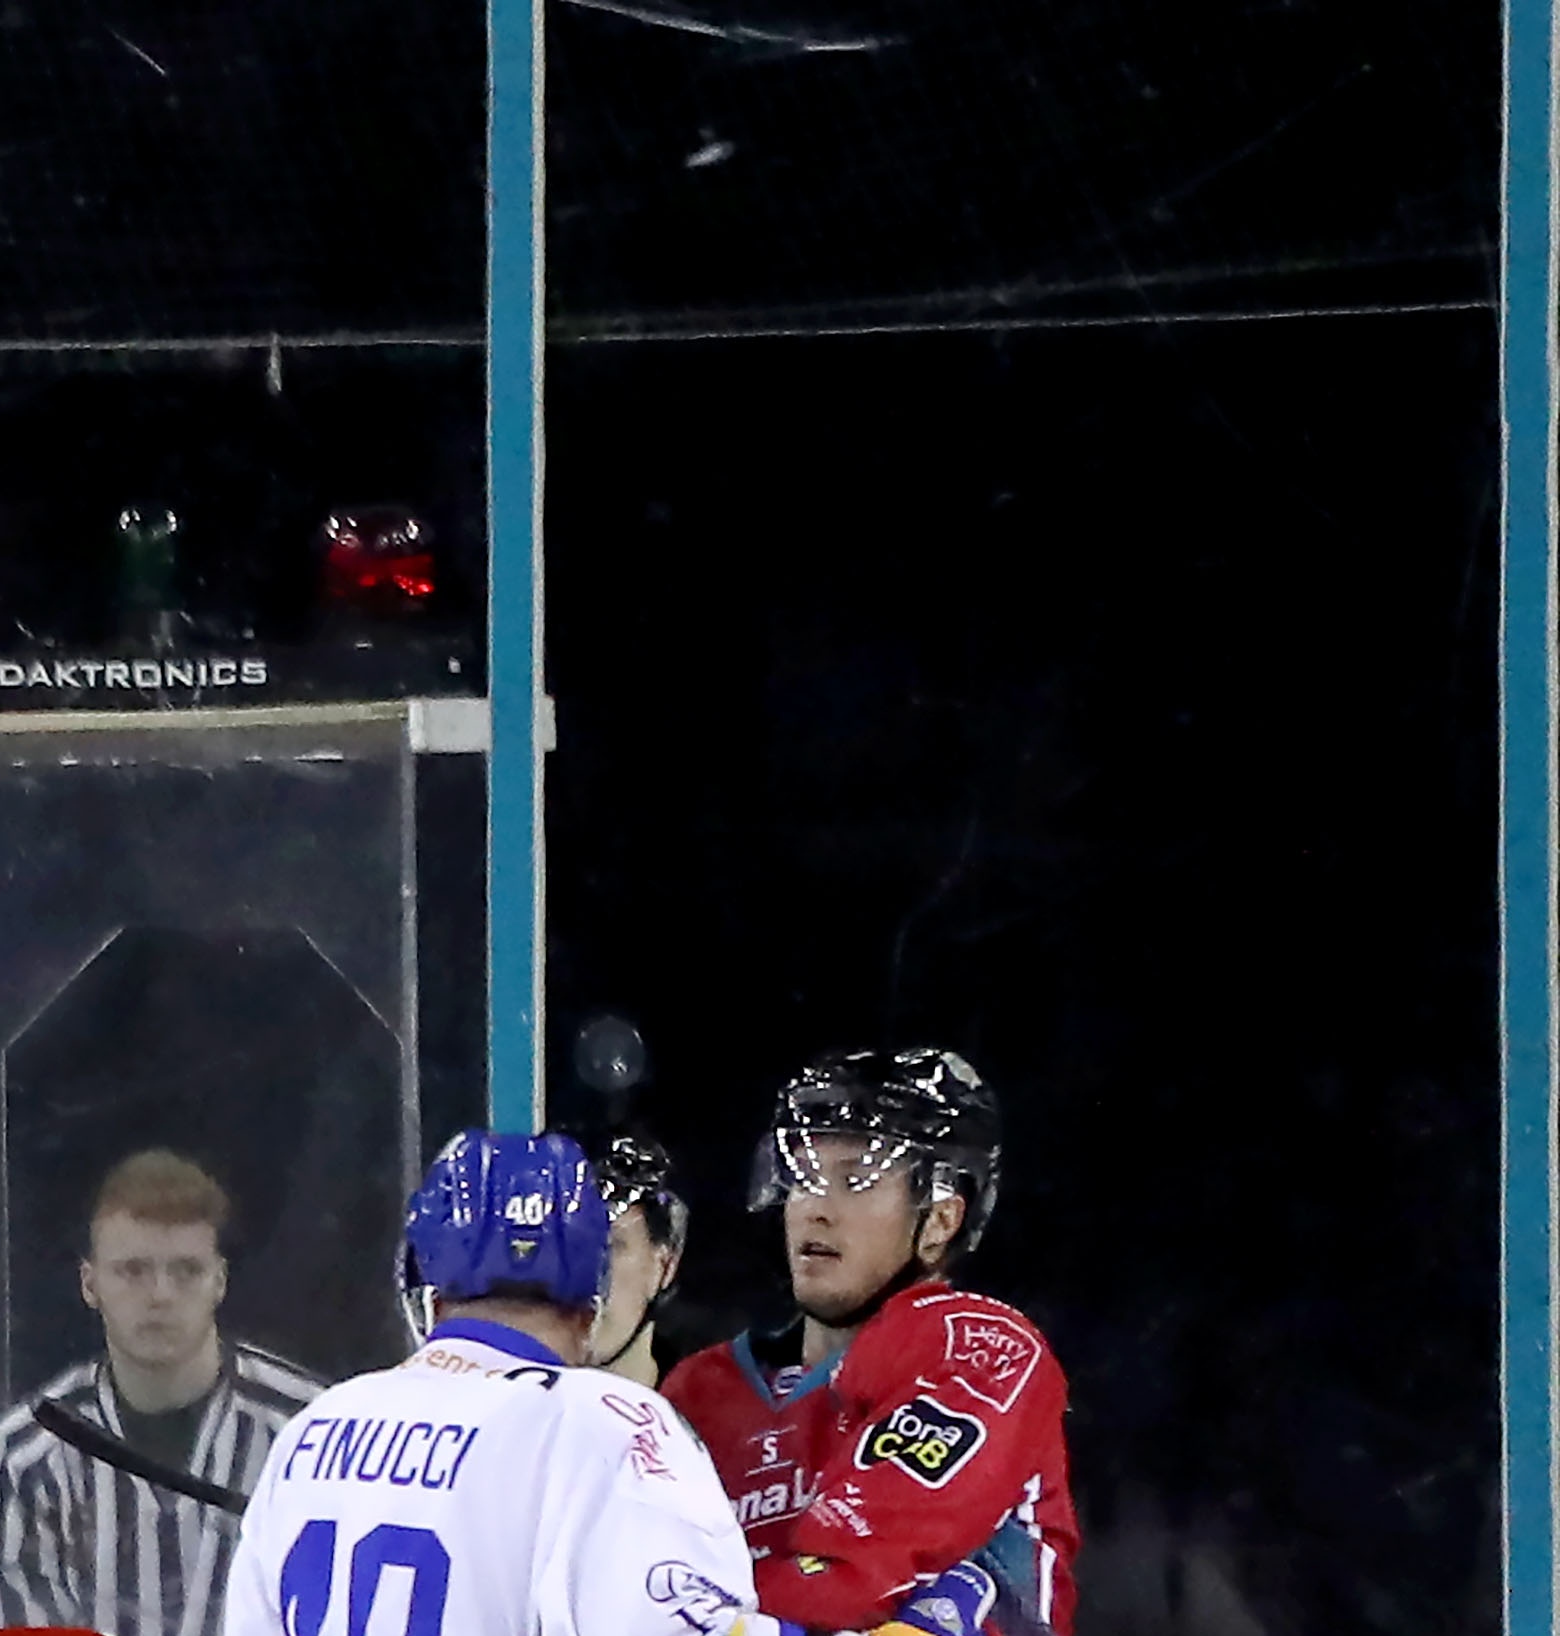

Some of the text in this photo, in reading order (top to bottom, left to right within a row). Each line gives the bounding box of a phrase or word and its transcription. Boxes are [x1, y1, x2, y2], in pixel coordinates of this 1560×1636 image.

[505, 1192, 544, 1226] 40
[887, 1405, 963, 1446] fona
[284, 1418, 480, 1490] FINUCCI
[874, 1432, 949, 1470] CB
